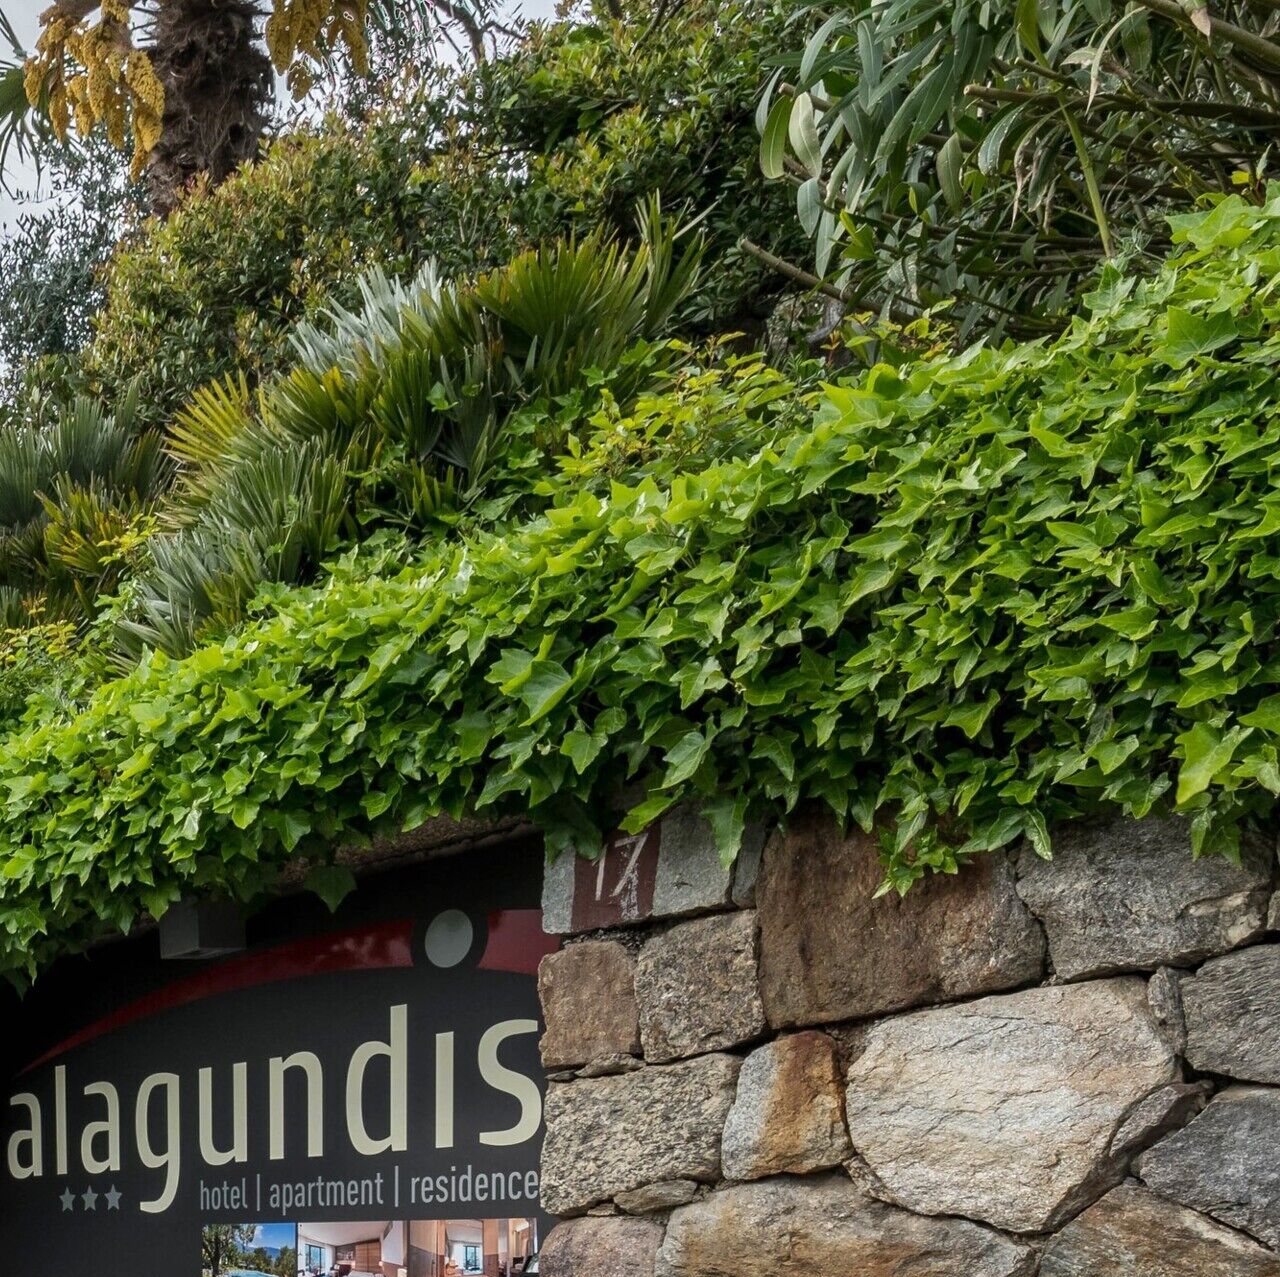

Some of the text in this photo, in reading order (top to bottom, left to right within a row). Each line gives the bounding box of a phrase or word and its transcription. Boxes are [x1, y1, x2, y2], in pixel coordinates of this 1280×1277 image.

[6, 1003, 543, 1214] alagundis
[199, 1164, 539, 1217] hotel apartment residence
